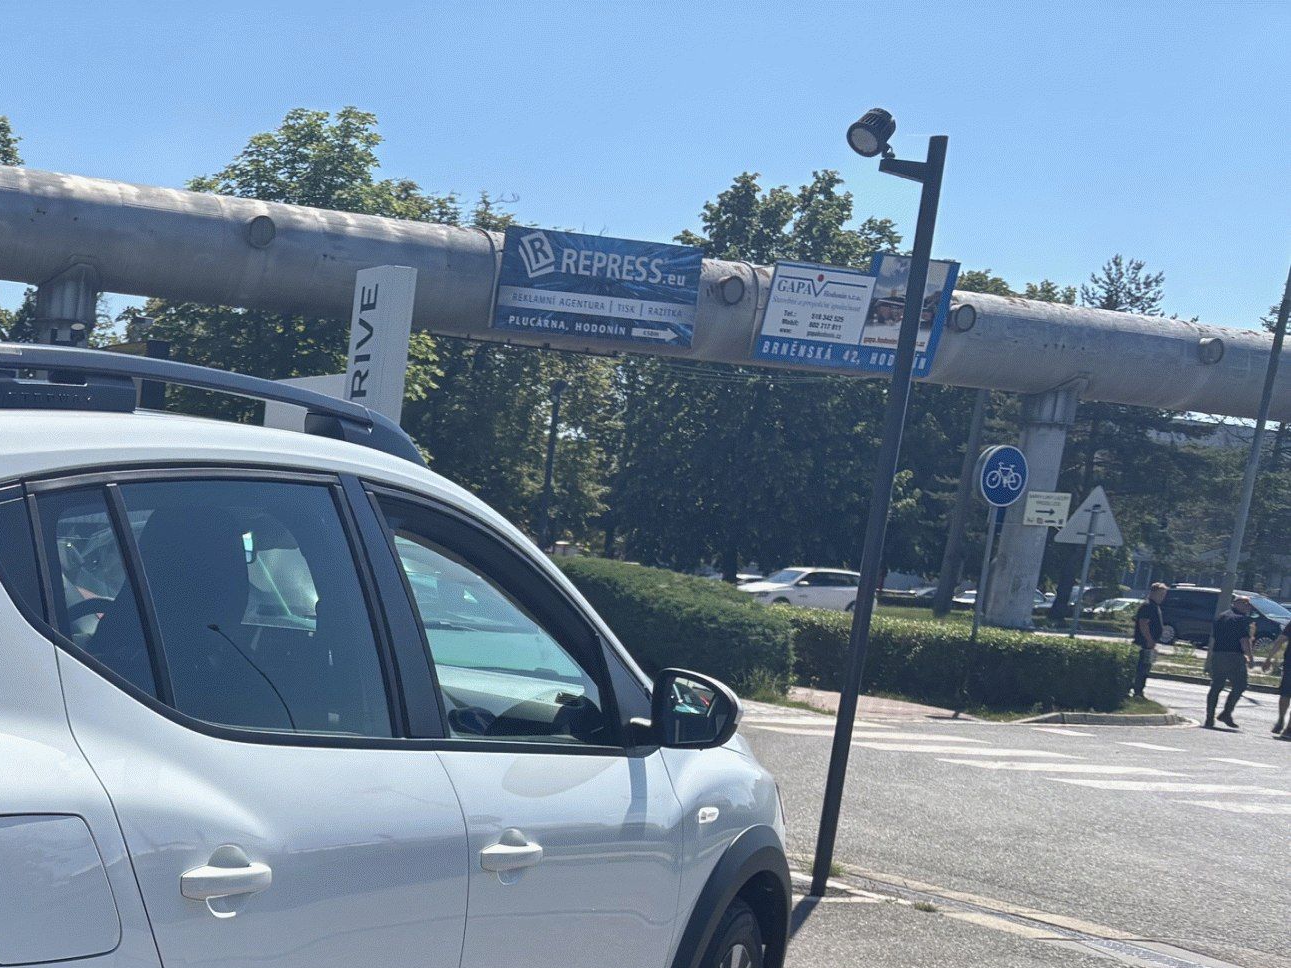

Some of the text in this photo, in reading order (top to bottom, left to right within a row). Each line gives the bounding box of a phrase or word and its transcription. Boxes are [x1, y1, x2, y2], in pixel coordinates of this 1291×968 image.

[560, 248, 686, 286] REPRESS.eu
[559, 299, 605, 311] AGENTURA
[616, 304, 635, 315] TISK
[574, 322, 626, 335] HODONÍN
[350, 283, 379, 400] RIVE
[842, 349, 860, 364] 42,
[869, 351, 927, 370] HODÍN
